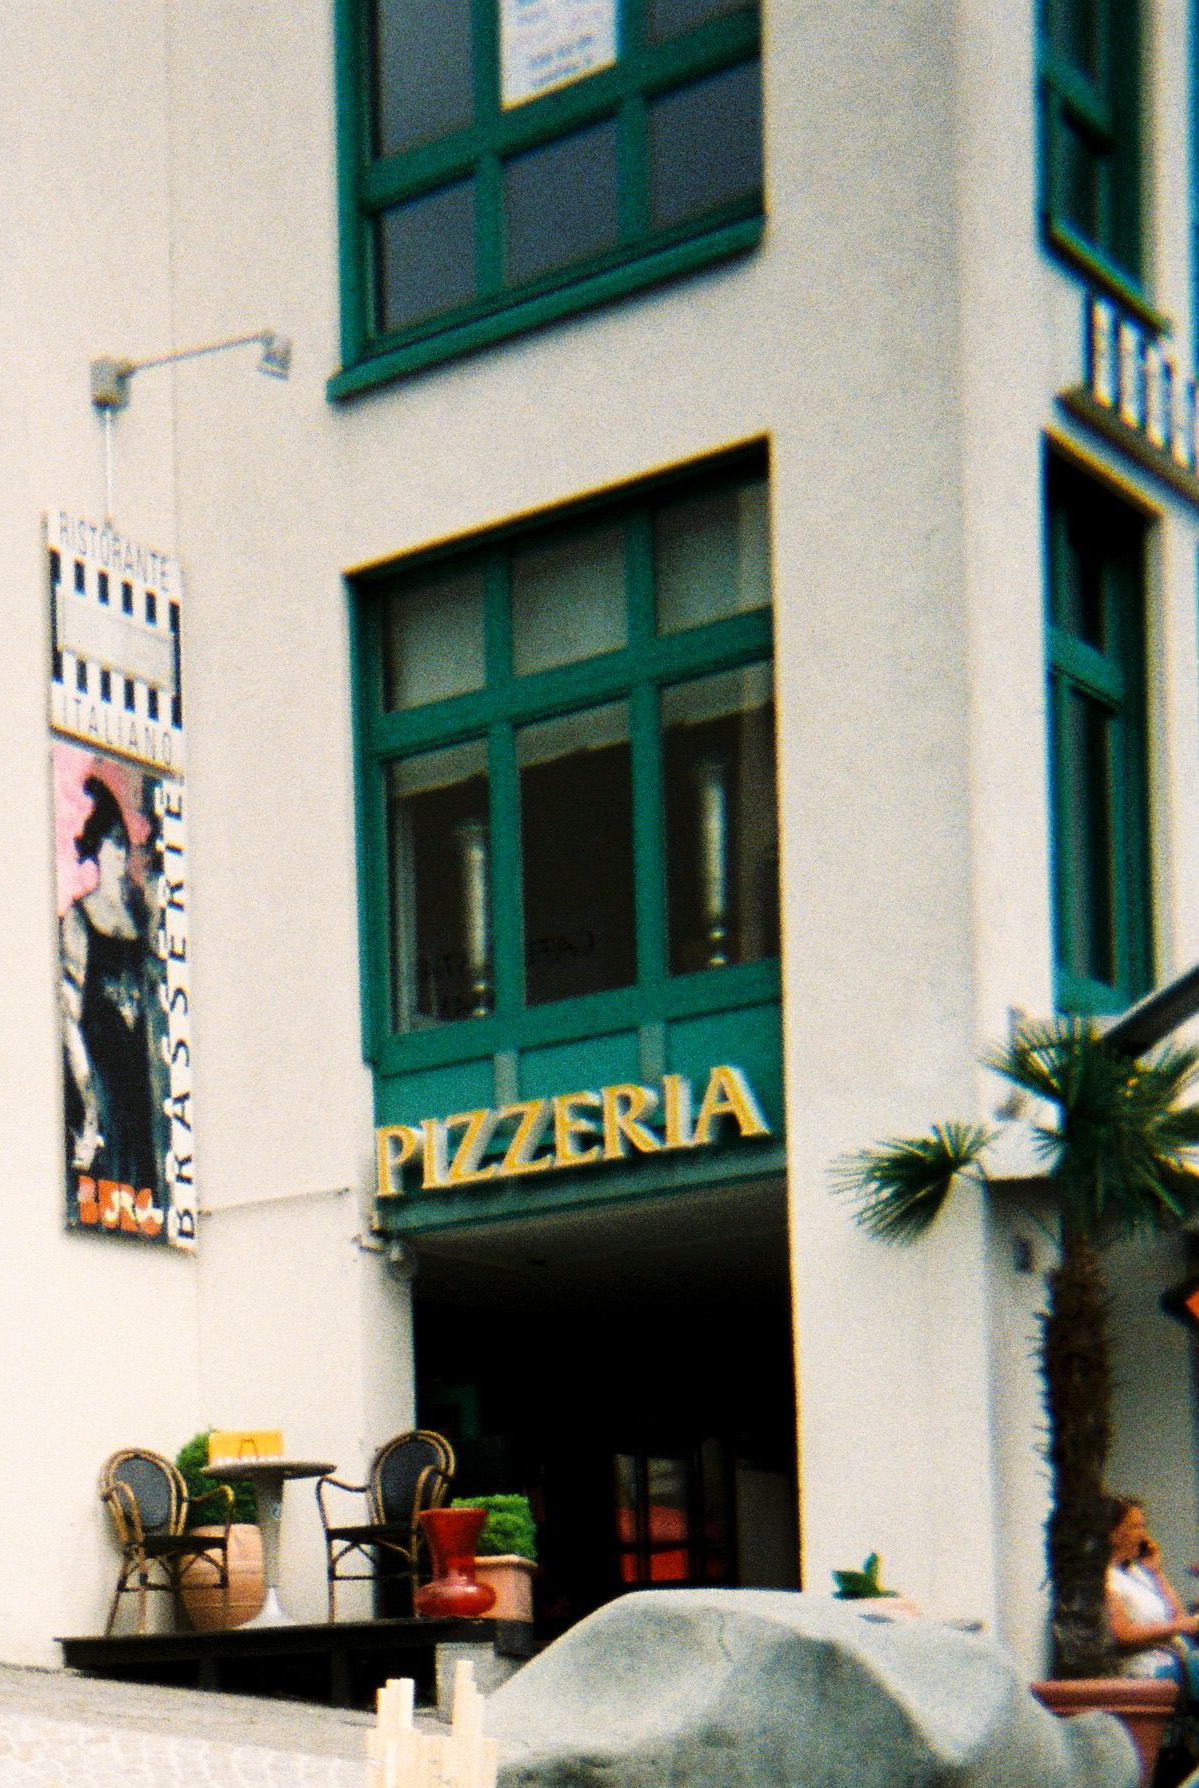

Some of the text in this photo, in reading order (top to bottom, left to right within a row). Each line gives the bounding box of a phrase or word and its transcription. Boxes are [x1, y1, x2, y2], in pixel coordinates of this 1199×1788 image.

[62, 695, 172, 767] ITALIANO
[161, 790, 196, 1241] BRASSERIE
[375, 1064, 772, 1197] PIZZERIA
